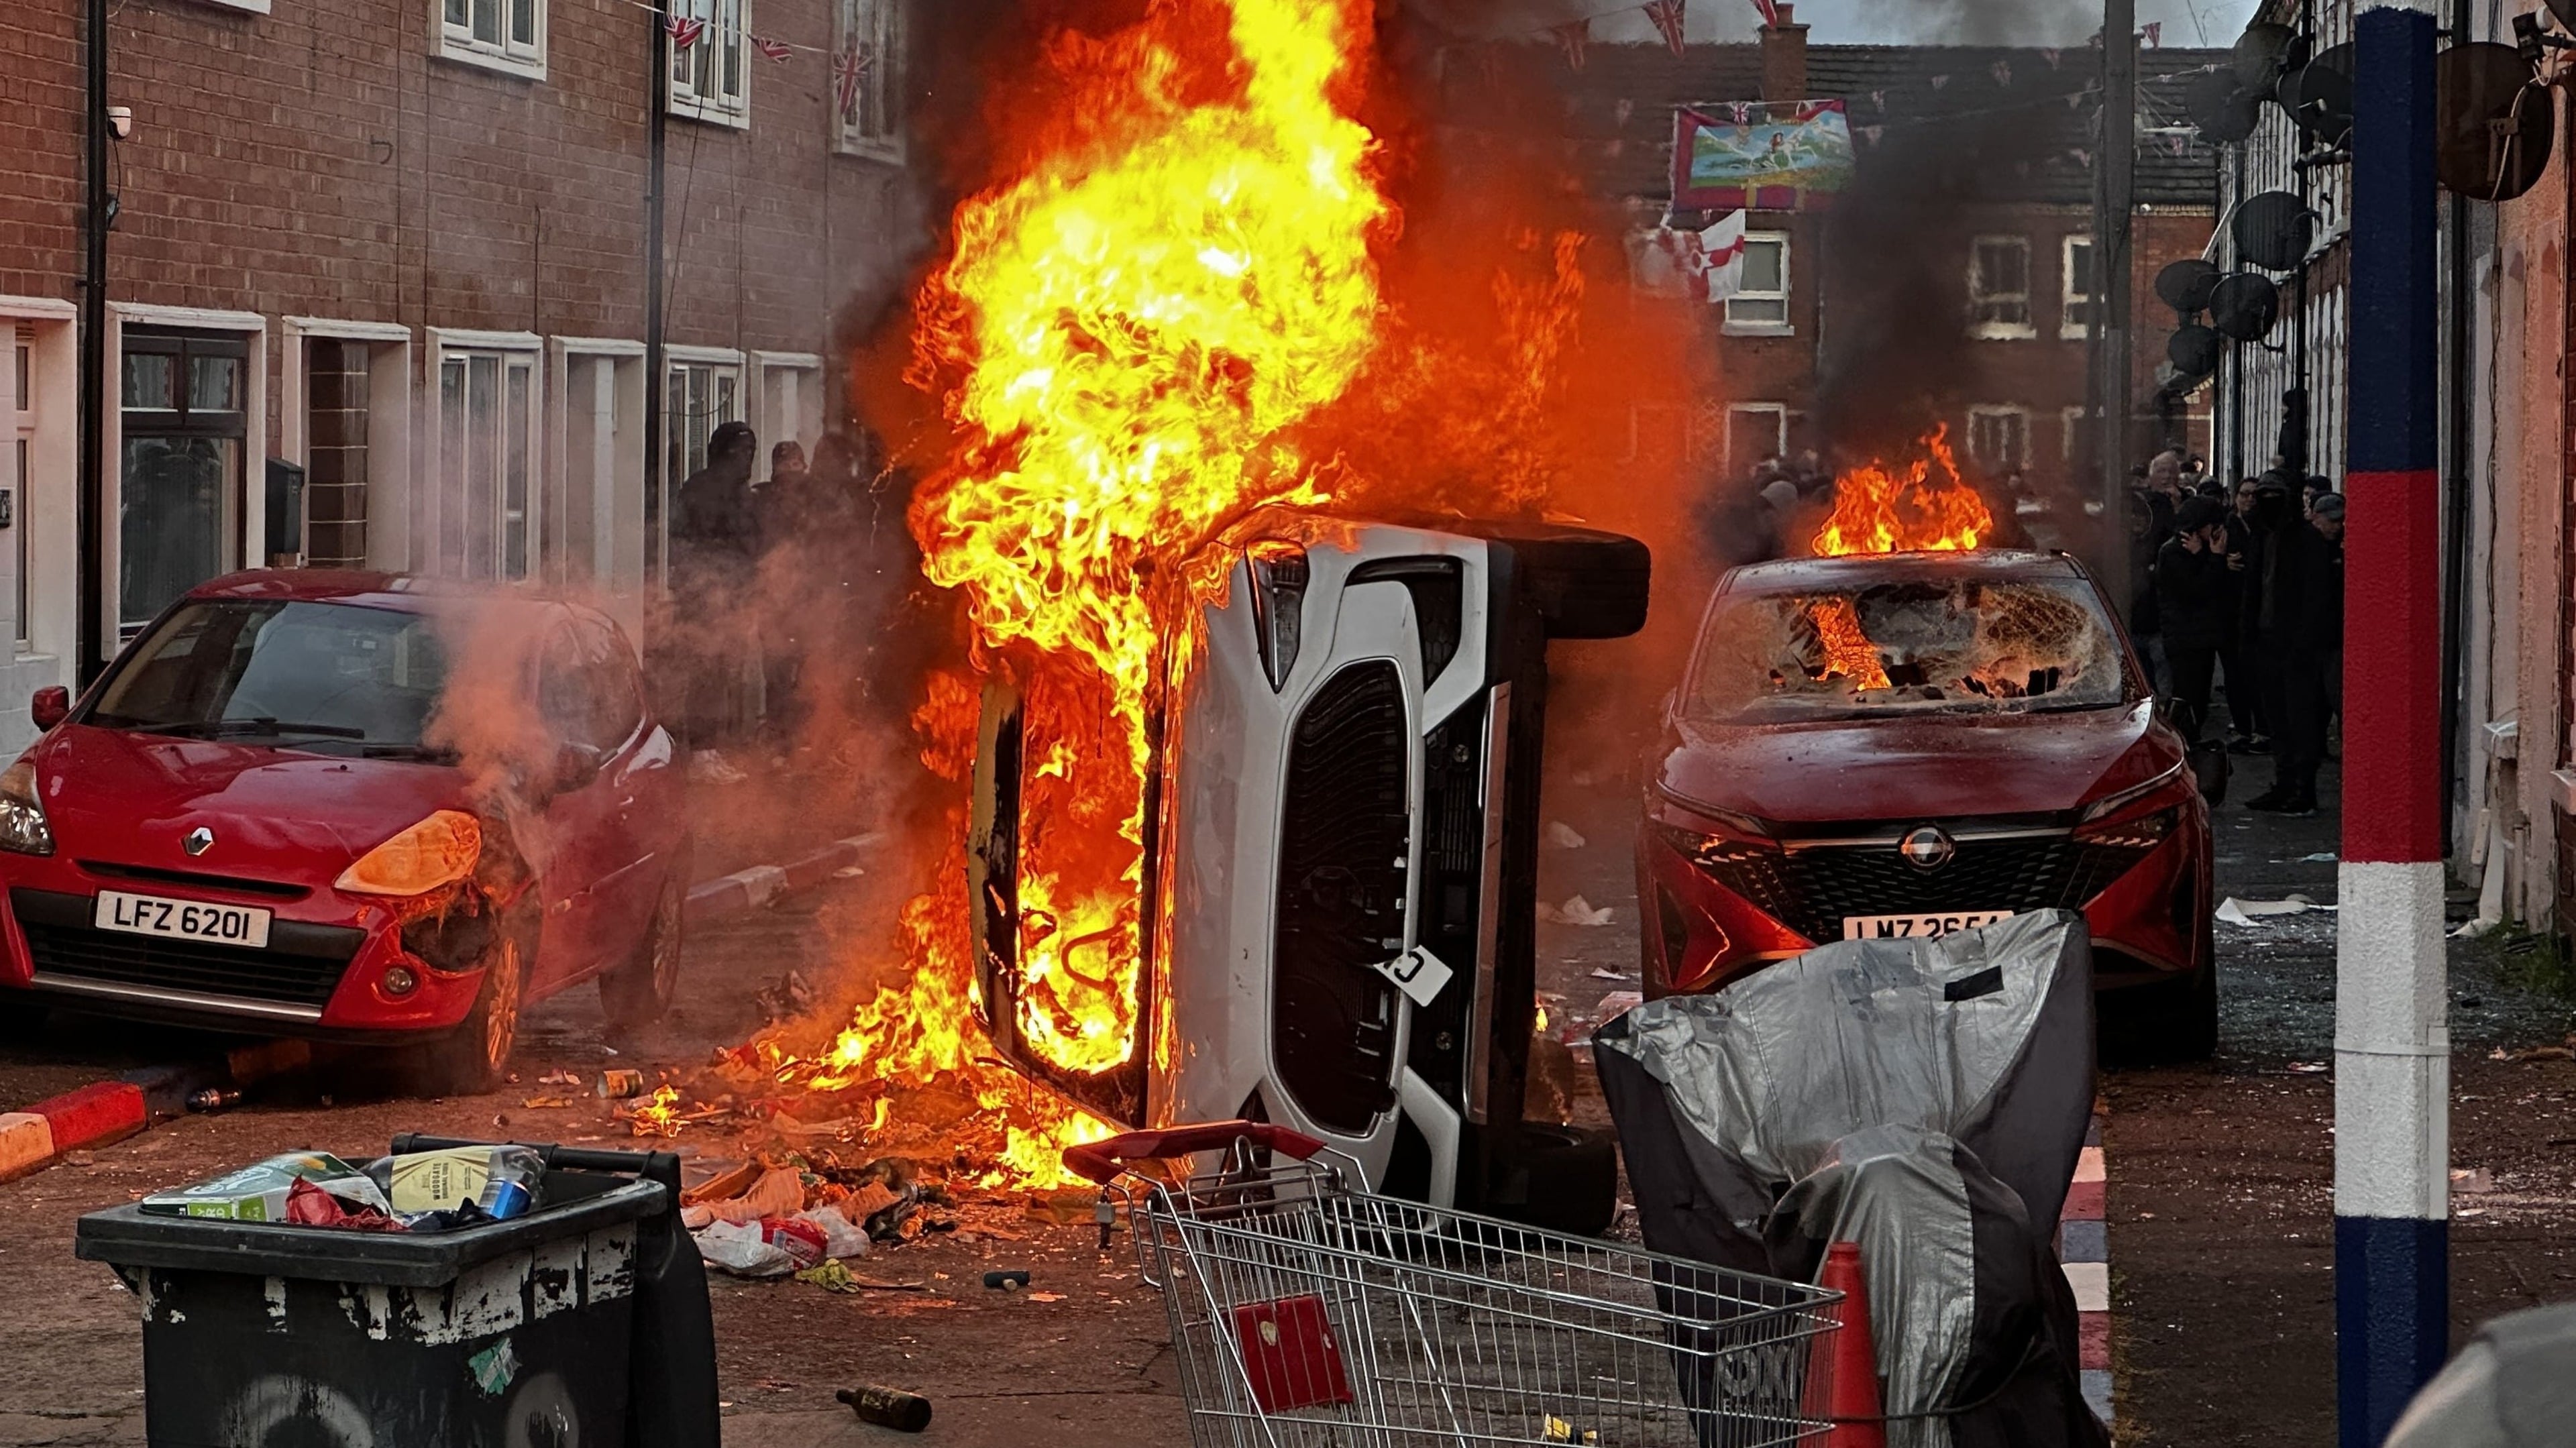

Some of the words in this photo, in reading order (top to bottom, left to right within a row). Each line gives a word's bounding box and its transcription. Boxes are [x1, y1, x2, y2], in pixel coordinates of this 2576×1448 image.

[114, 897, 173, 931] LFZ
[181, 907, 250, 940] 6201
[432, 1163, 441, 1201] WOODGATE
